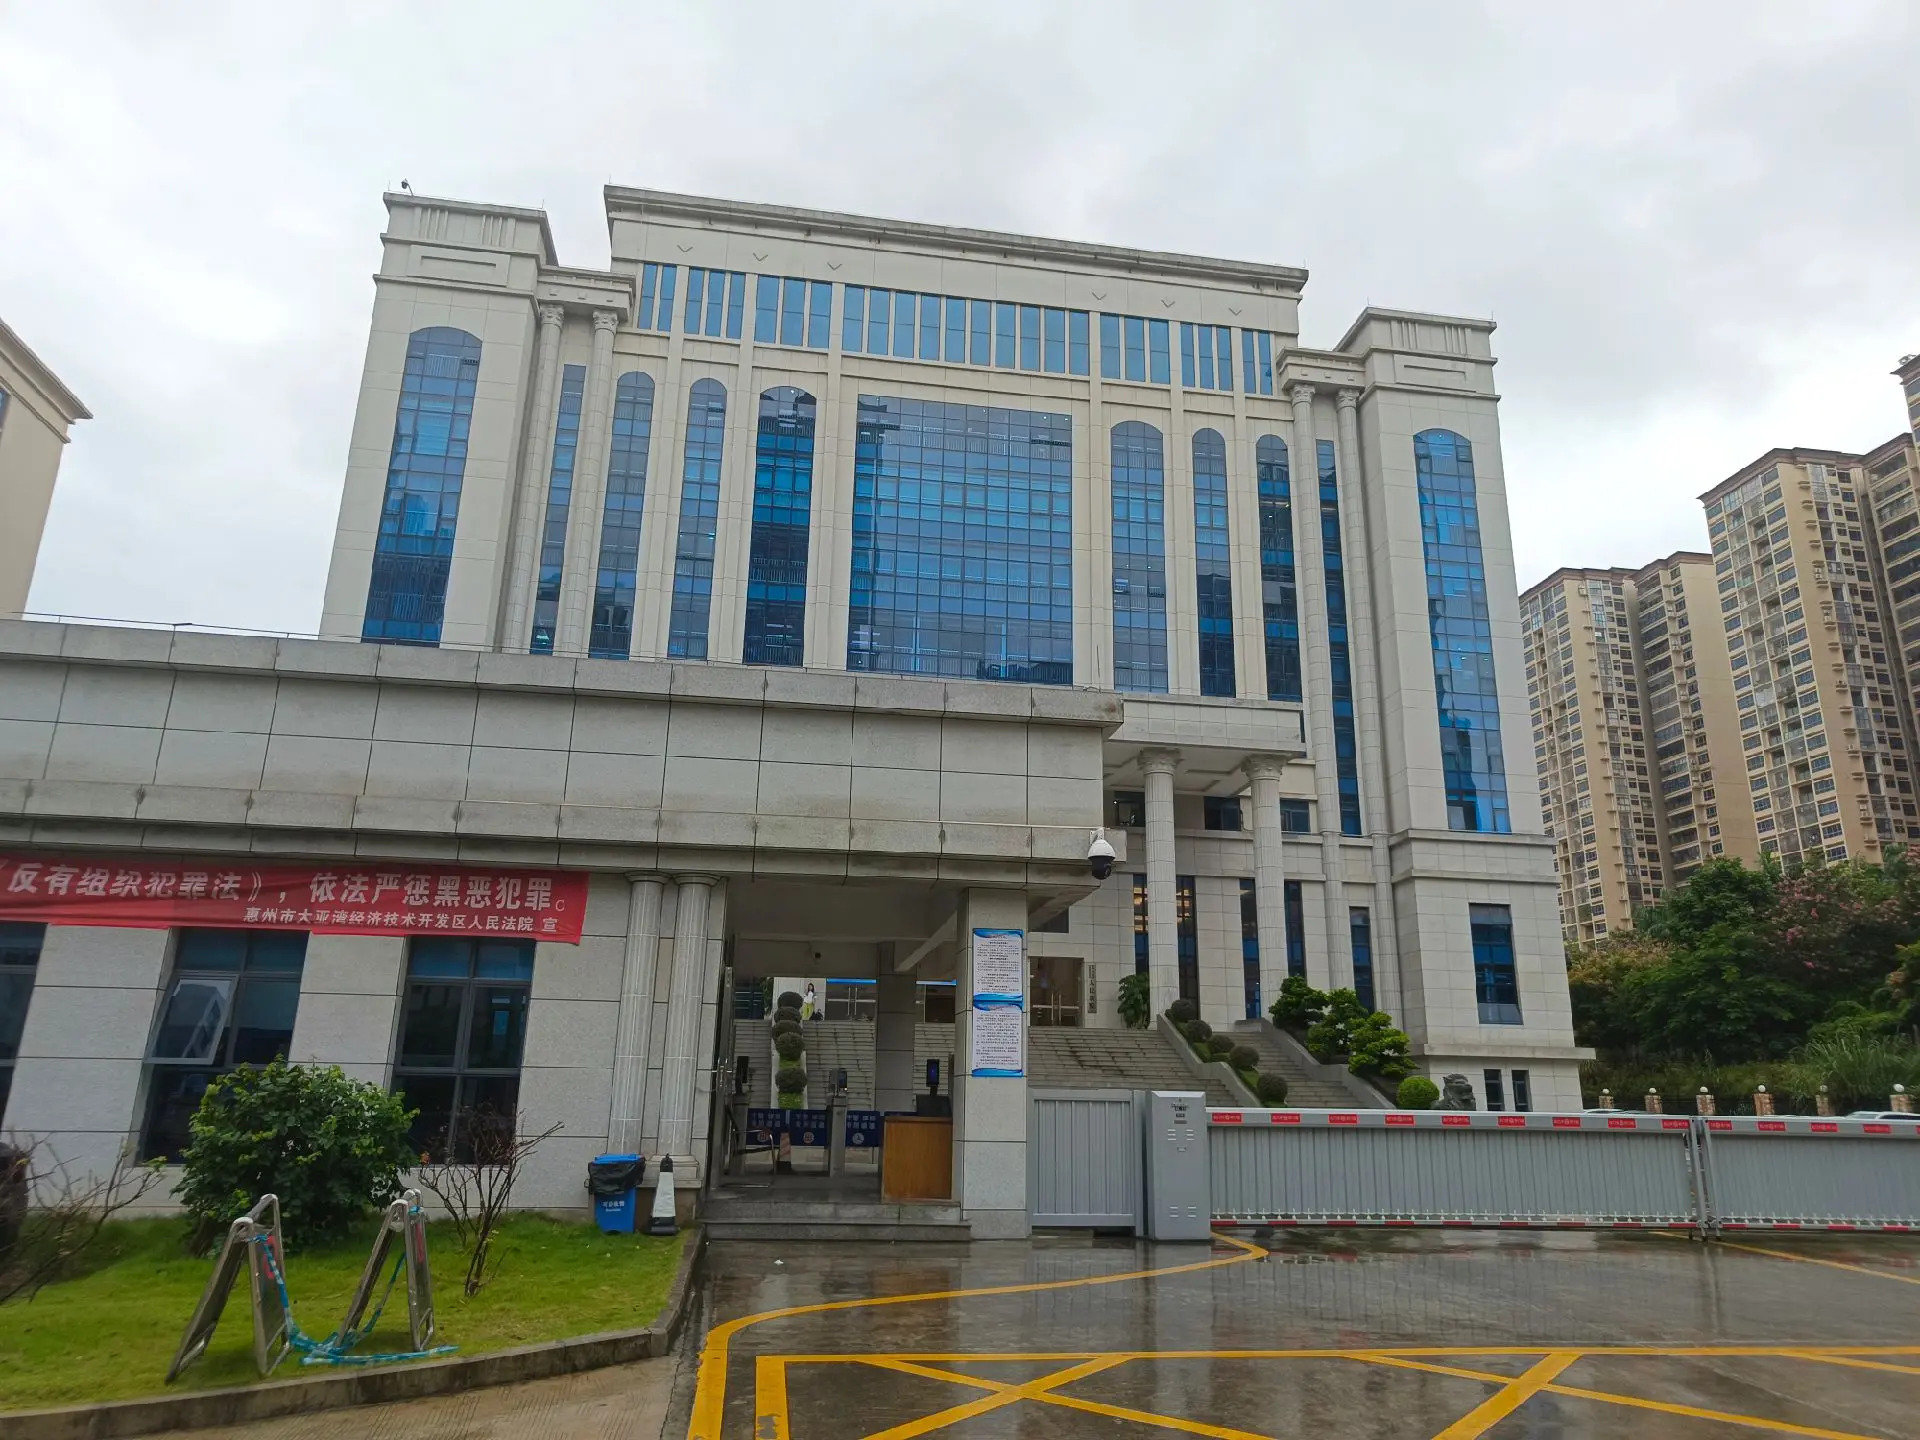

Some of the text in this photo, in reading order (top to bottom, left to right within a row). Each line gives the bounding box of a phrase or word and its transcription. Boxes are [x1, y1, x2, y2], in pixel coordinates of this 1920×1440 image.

[243, 907, 559, 933] 惠州市大亚湾经济技术开发区人民法院 宣
